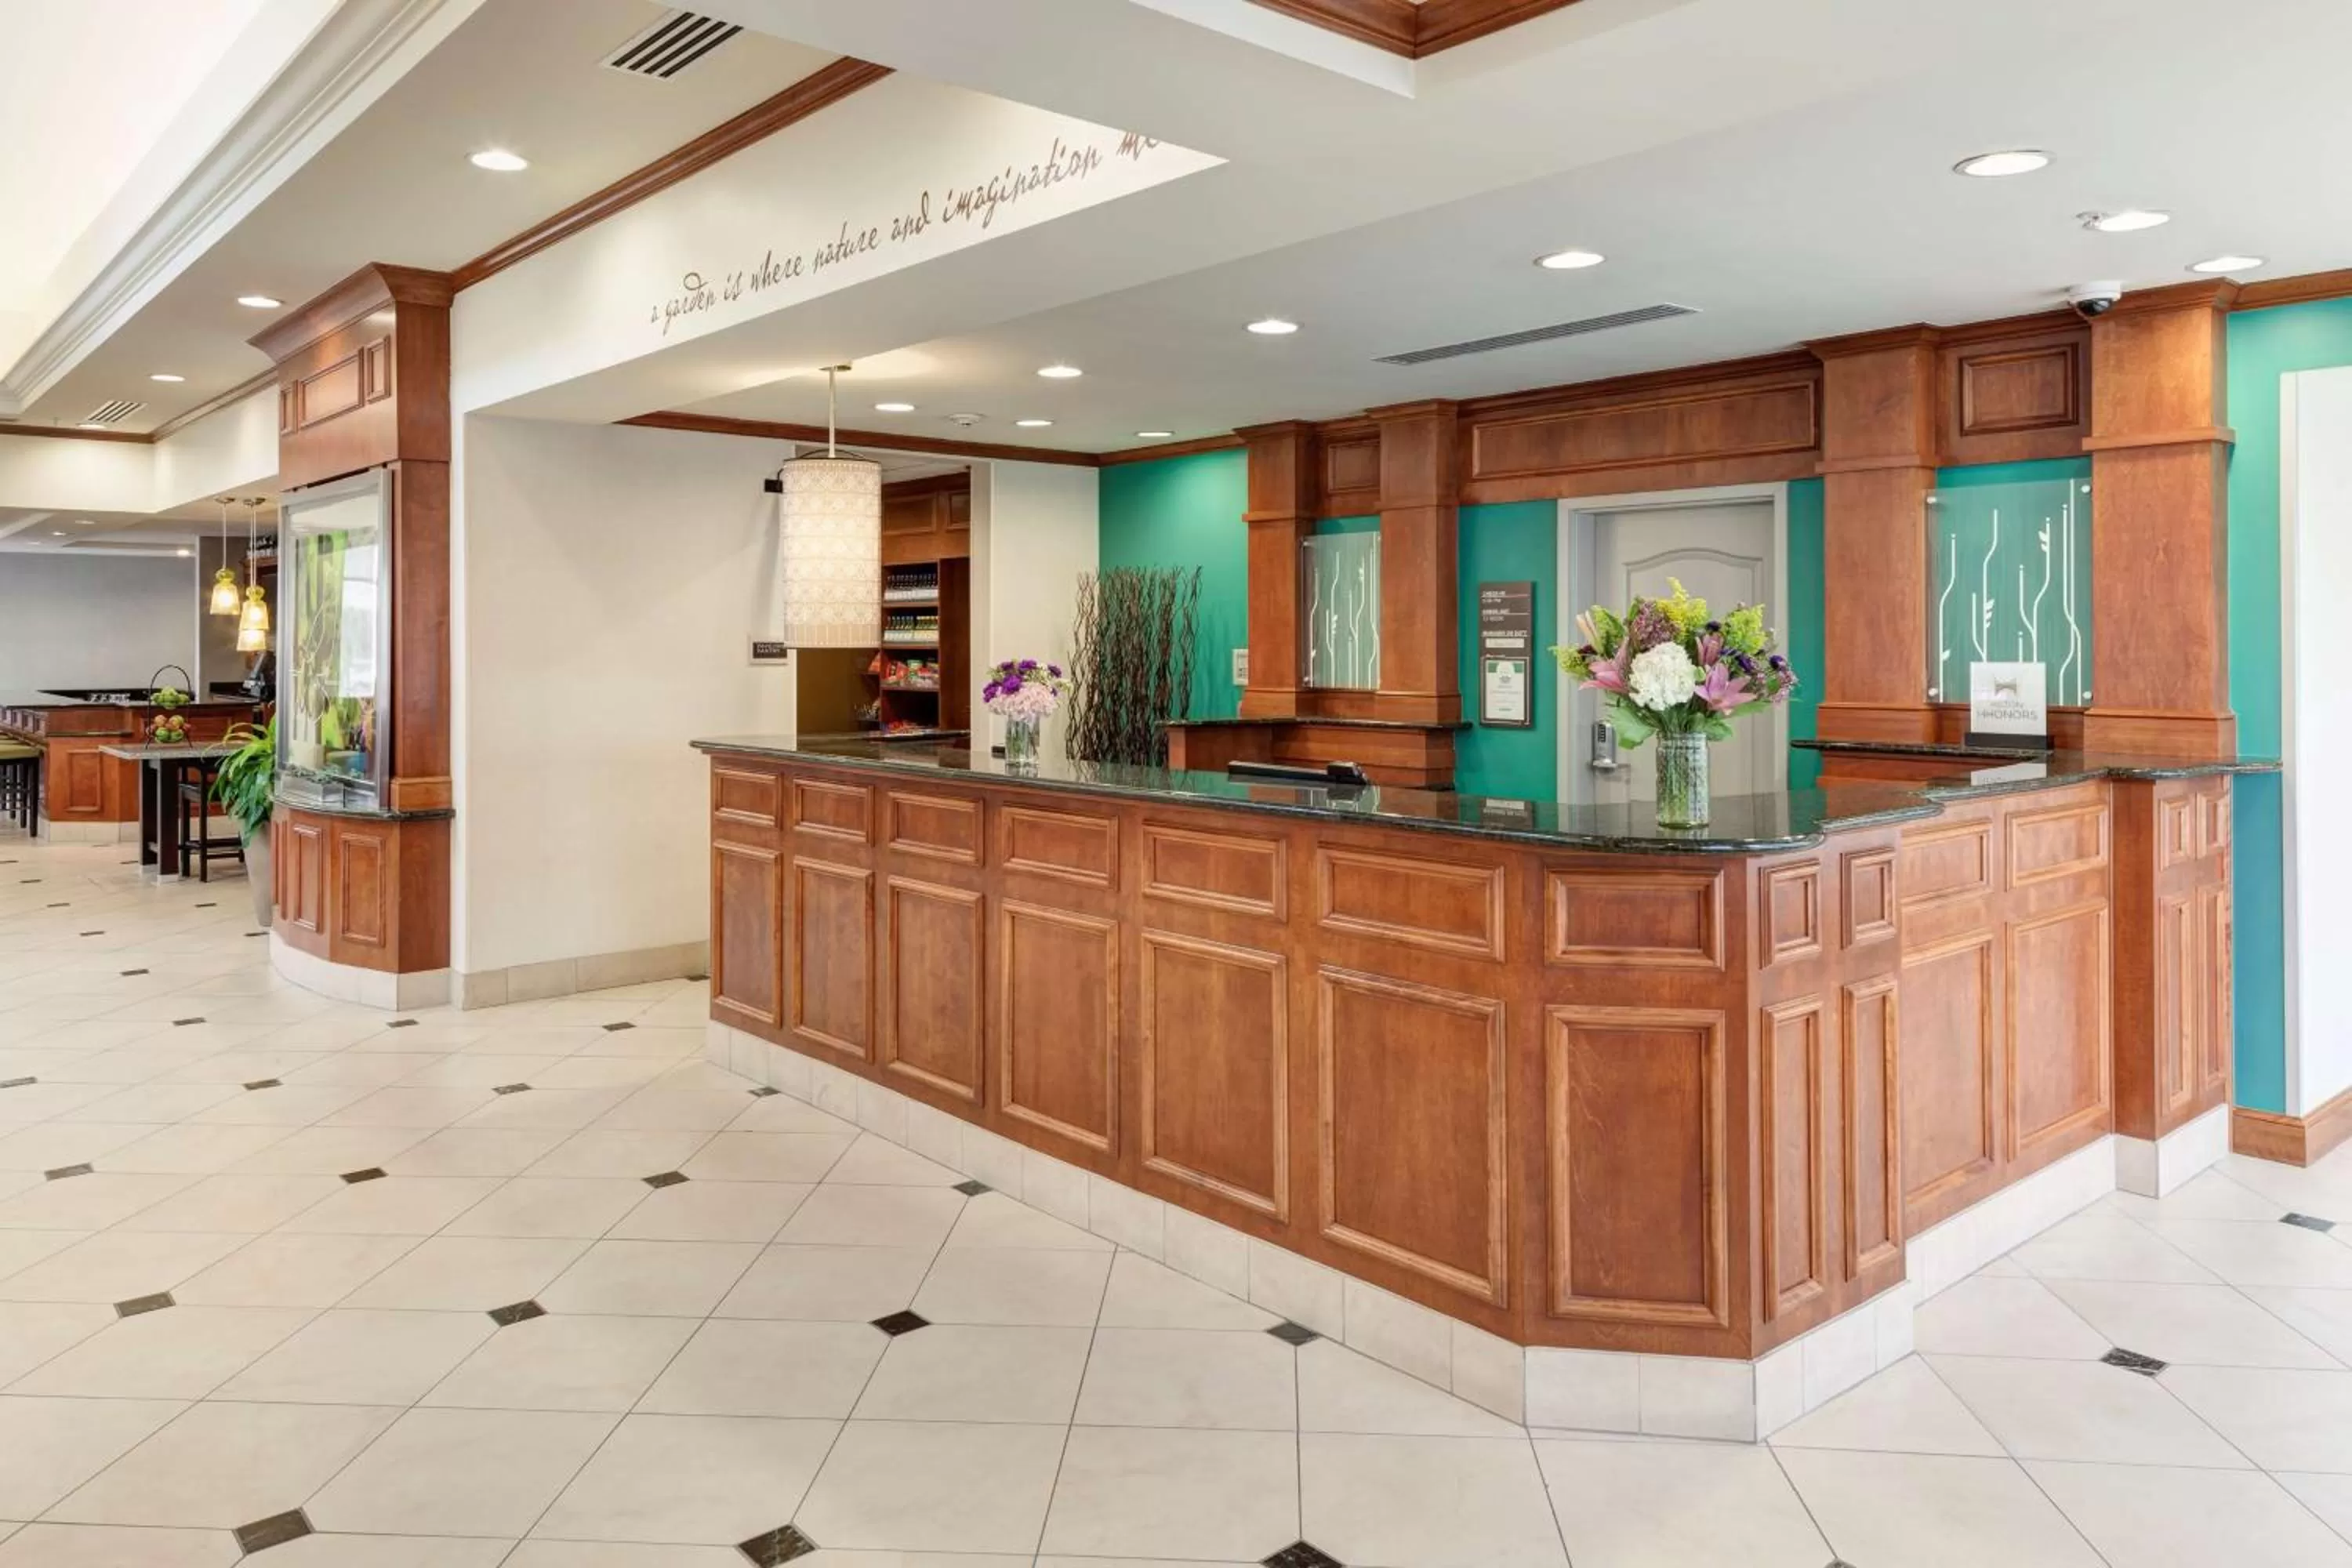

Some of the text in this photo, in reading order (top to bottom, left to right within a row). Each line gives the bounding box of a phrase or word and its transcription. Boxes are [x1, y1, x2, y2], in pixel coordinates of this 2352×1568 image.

[651, 305, 659, 323] a
[662, 272, 717, 336] garden
[723, 270, 743, 302] is
[750, 250, 804, 292] where
[812, 220, 882, 274] nature
[891, 190, 932, 243] and
[942, 136, 1103, 230] imagination
